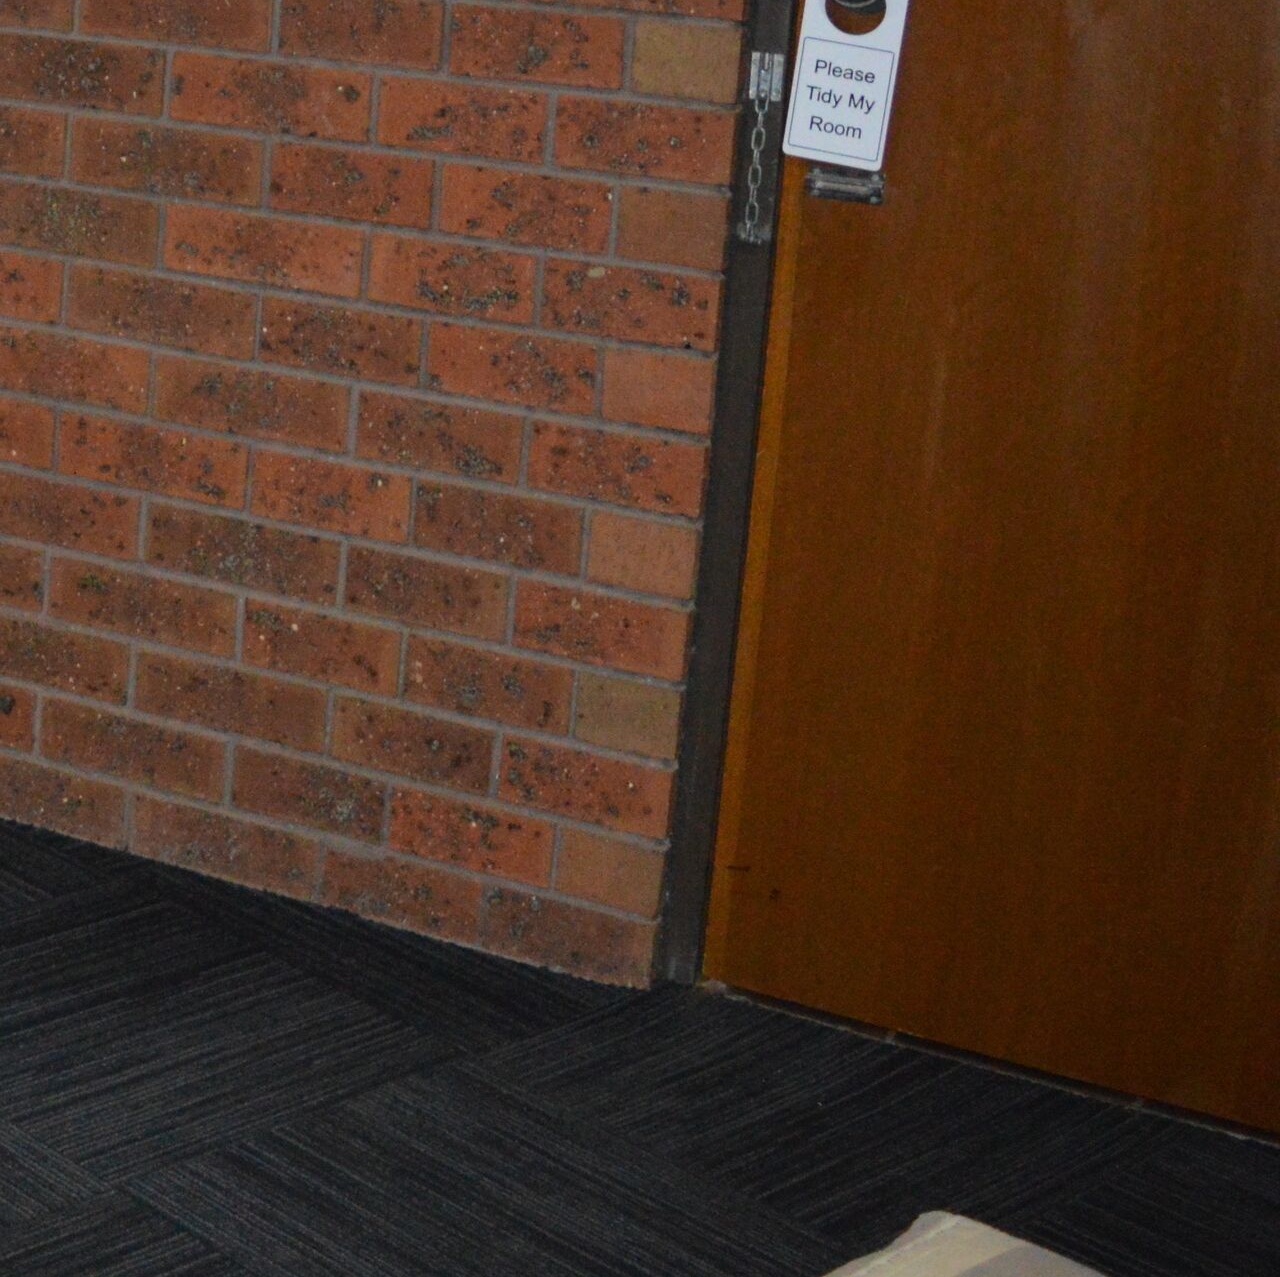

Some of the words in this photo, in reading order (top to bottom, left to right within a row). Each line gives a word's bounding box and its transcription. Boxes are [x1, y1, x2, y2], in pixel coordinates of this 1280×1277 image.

[814, 59, 876, 84] Please
[806, 85, 843, 109] Tidy
[848, 93, 876, 115] My
[809, 115, 862, 140] Room
